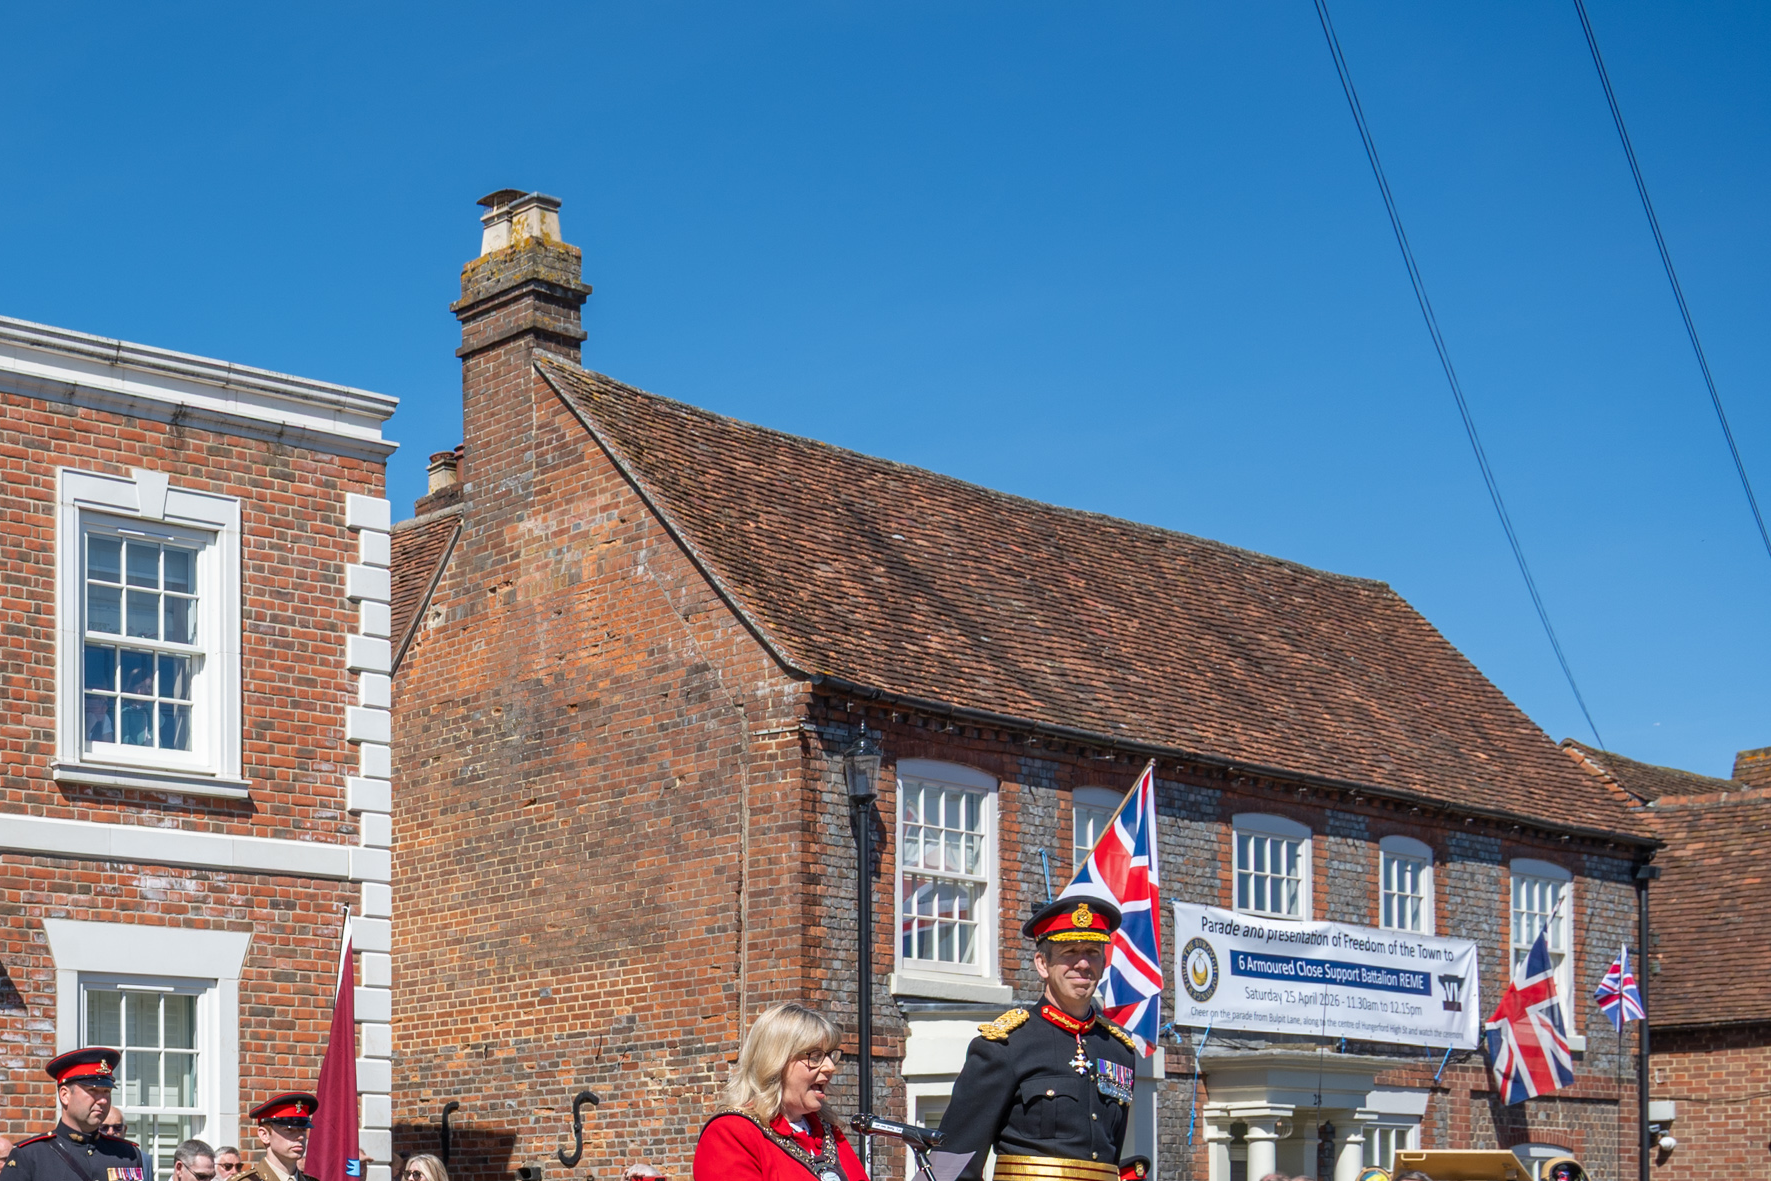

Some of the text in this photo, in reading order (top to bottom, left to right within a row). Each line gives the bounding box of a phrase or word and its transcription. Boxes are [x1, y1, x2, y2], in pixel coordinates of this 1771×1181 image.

[1201, 916, 1454, 962] Parade and presentation of Freedom of the Town to
[1238, 955, 1424, 989] 6 Armoured Close Support Battalion REME
[1244, 986, 1282, 1005] Saturday
[1285, 990, 1296, 1004] 25
[1298, 992, 1318, 1007] April
[1319, 992, 1340, 1007] 2026
[1346, 995, 1379, 1011] 11.30am
[1380, 1001, 1388, 1012] to
[1390, 1001, 1422, 1018] 12.15pm
[1444, 982, 1458, 1002] VI
[1191, 1006, 1209, 1017] Cheer
[1210, 1010, 1218, 1018] on
[1220, 1009, 1231, 1019] the
[1232, 1010, 1253, 1022] parade
[1254, 1011, 1268, 1022] from
[1269, 1013, 1286, 1024] Bulpit
[1287, 1015, 1302, 1026] Lane,
[1303, 1016, 1319, 1027] along
[1320, 1018, 1326, 1027] to
[1327, 1018, 1337, 1027] the
[1338, 1019, 1354, 1028] centre
[1355, 1020, 1361, 1029] of
[1362, 1021, 1389, 1033] Hungerford
[1390, 1024, 1401, 1035] High
[1402, 1026, 1408, 1034] St
[1409, 1026, 1418, 1035] and
[1419, 1027, 1433, 1036] watch
[1434, 1028, 1442, 1037] the
